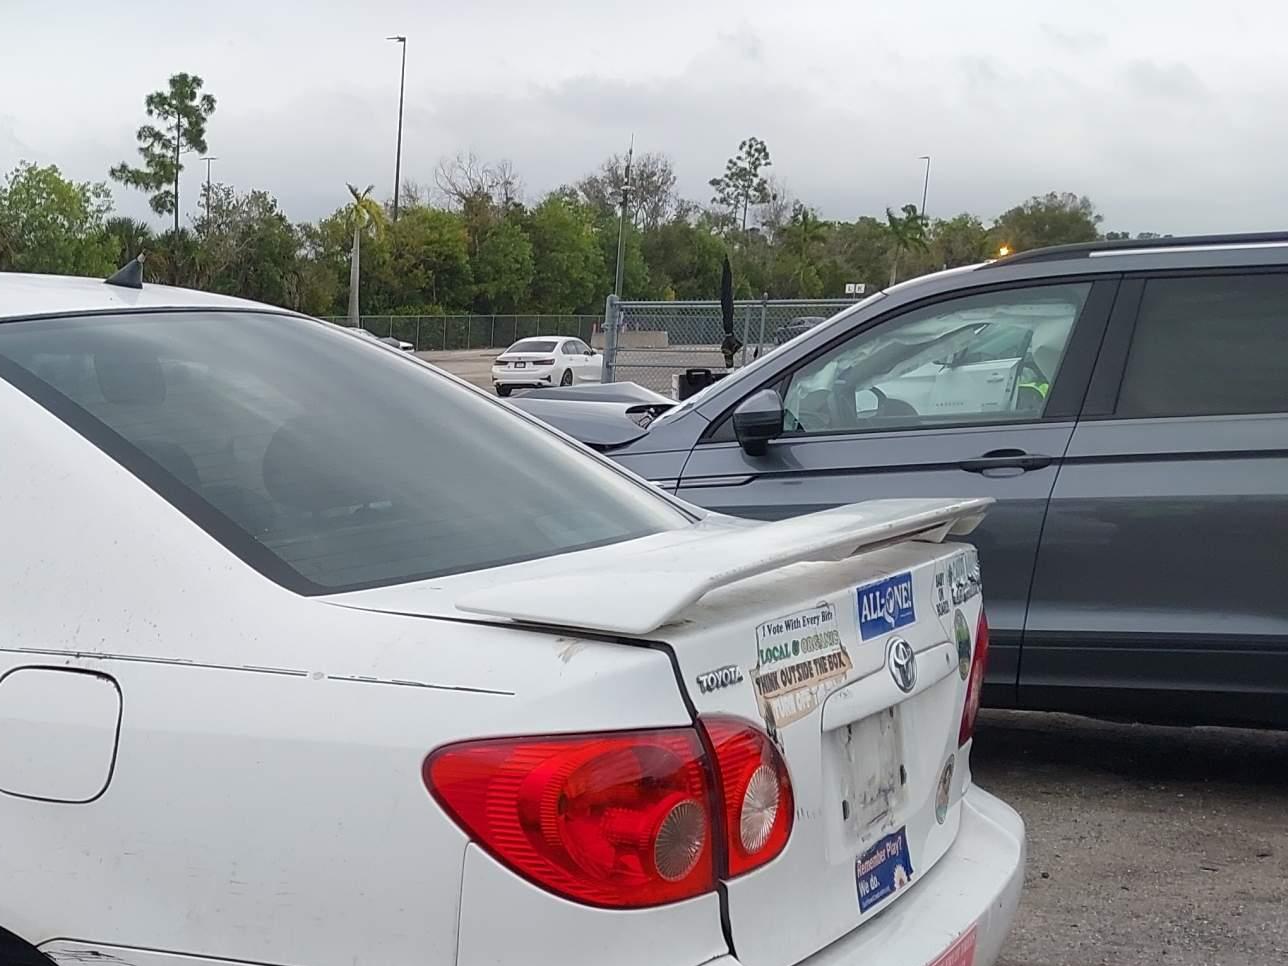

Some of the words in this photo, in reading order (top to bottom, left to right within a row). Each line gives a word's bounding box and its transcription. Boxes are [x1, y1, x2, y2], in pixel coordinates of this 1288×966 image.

[861, 580, 913, 624] ALL-ONE!
[762, 626, 766, 638] I
[767, 623, 783, 637] Vote
[784, 618, 801, 632] With
[802, 613, 820, 627] Every
[760, 642, 792, 665] LOCAL
[800, 630, 840, 654] ORGANIC
[696, 665, 744, 694] TOYOTA
[755, 671, 781, 696] THINK
[780, 660, 814, 687] OUTSIDE
[813, 655, 828, 677] THE
[828, 651, 846, 672] BOX
[857, 849, 886, 879] Remember
[886, 835, 902, 858] Play?
[859, 879, 870, 897] We
